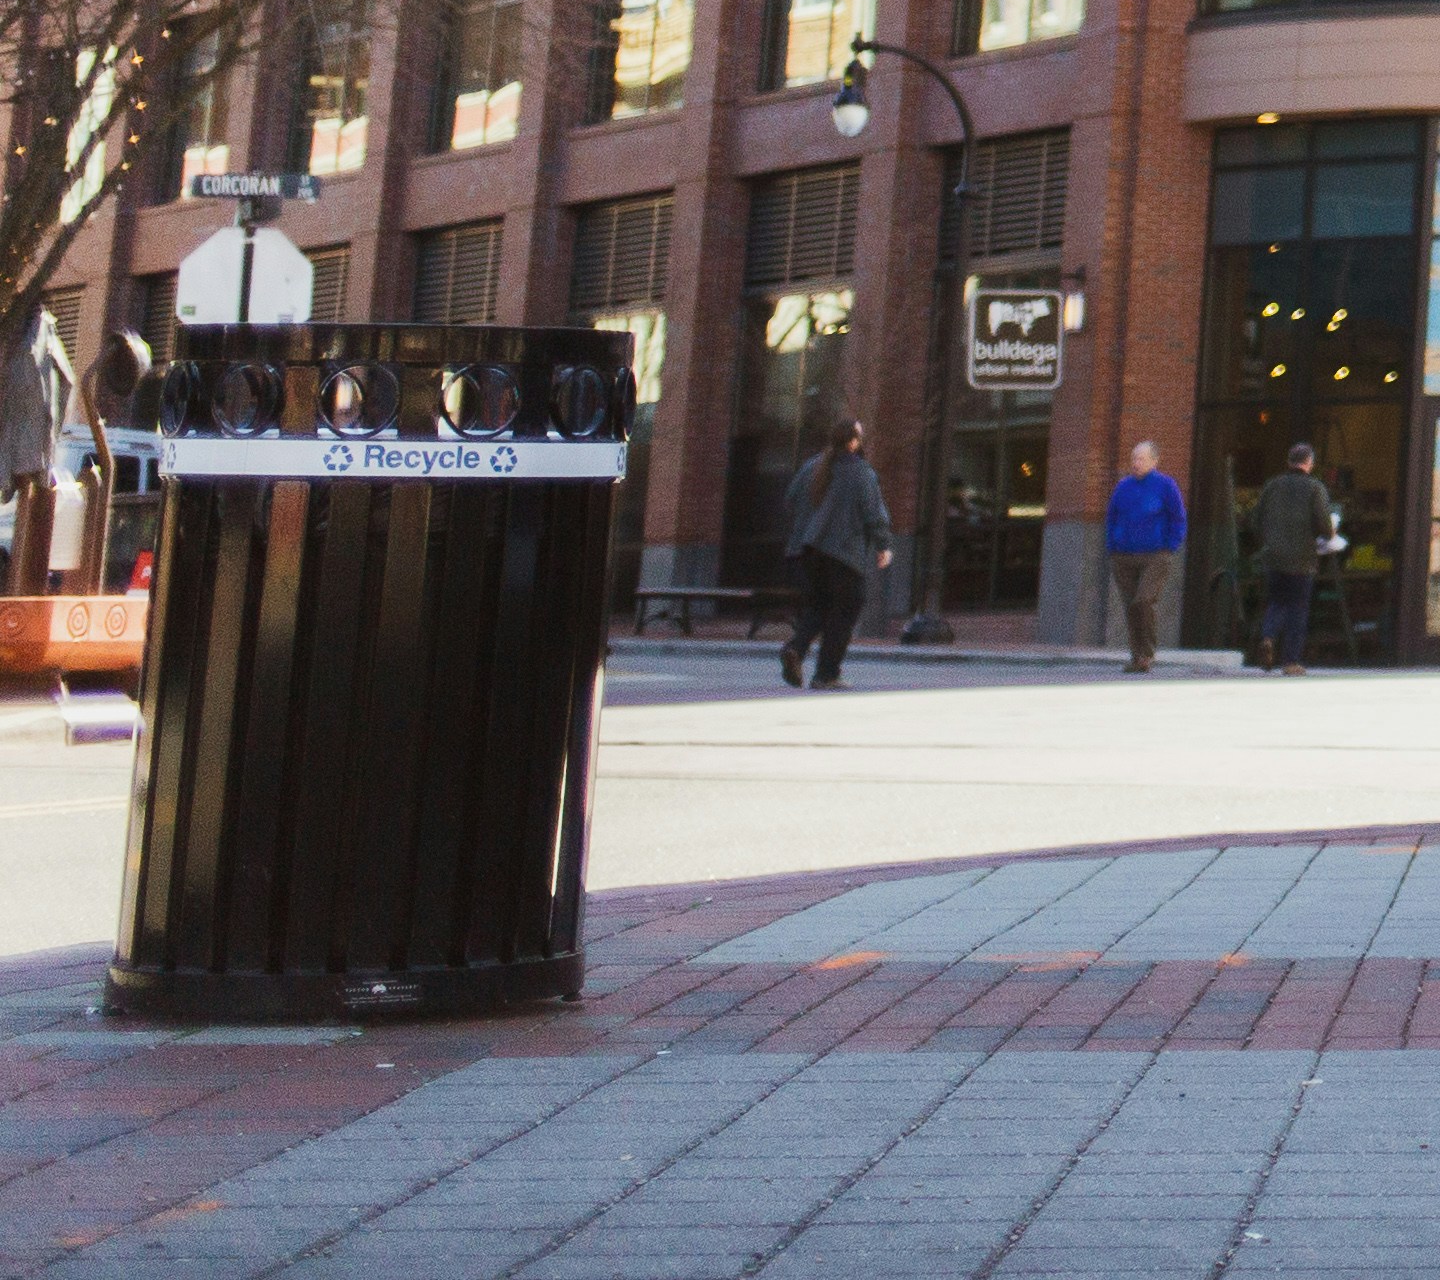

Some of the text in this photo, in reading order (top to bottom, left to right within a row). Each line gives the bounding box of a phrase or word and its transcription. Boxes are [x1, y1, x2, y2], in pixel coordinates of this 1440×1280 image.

[202, 175, 280, 196] CORCORAN
[975, 340, 1057, 365] bulldega
[363, 445, 481, 474] Recycle
